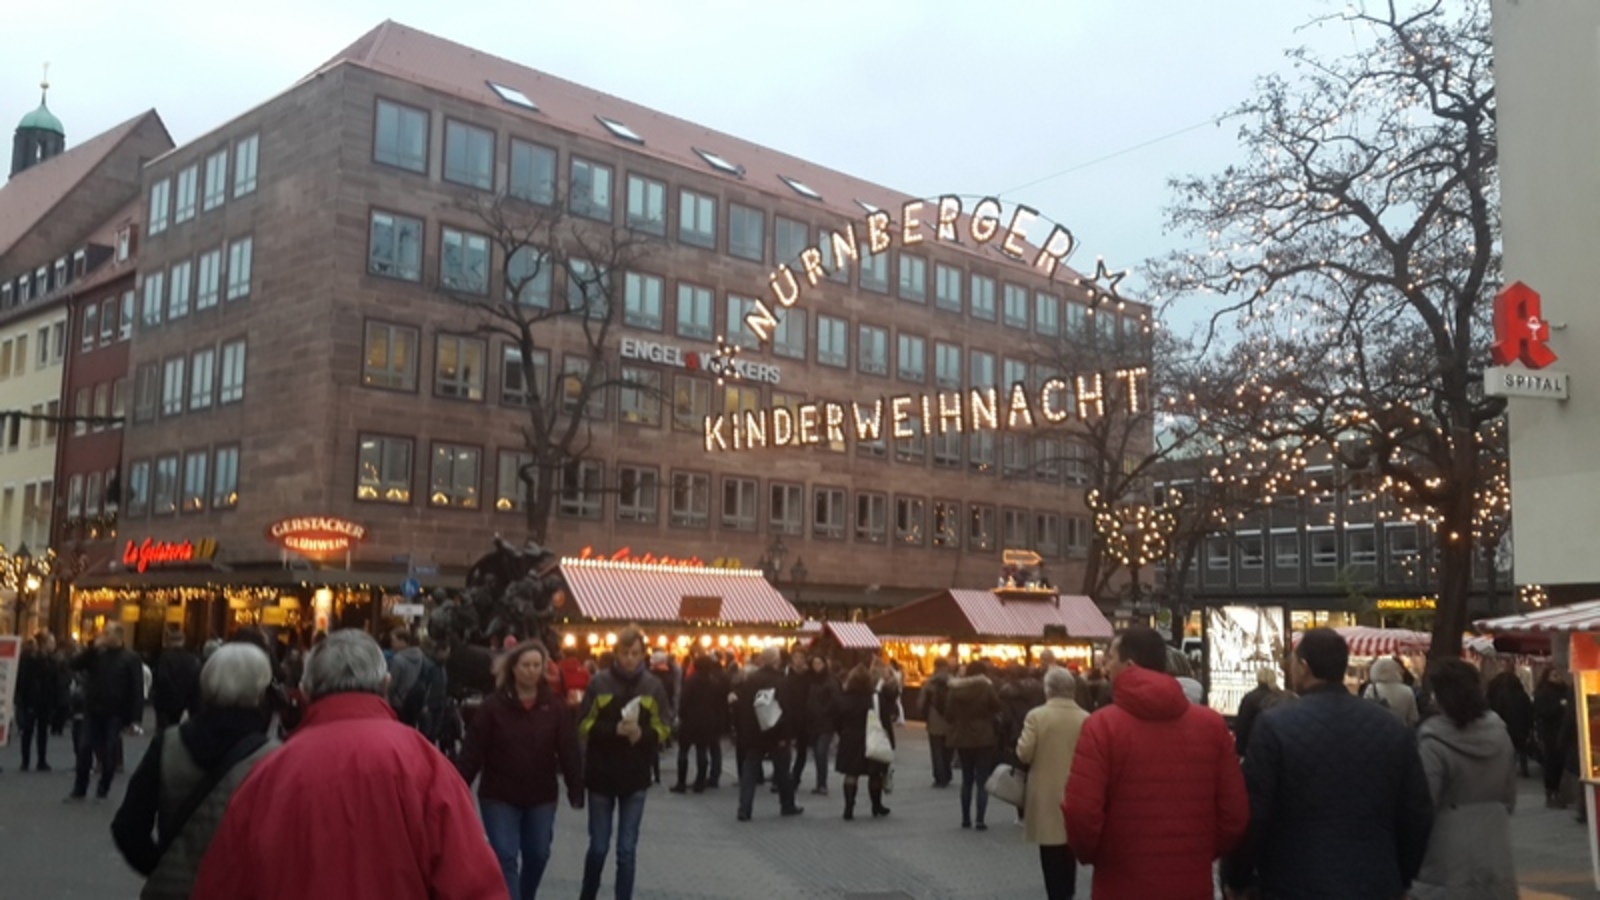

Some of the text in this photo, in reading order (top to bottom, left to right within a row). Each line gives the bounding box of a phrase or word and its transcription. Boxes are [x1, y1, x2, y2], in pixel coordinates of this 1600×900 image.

[744, 193, 1074, 342] NÜRNBERGER
[620, 337, 686, 368] ENGEL
[1504, 374, 1562, 392] SPITAL
[703, 366, 1148, 452] KINDERWEIHNACHT
[271, 516, 365, 539] GERSTACKER
